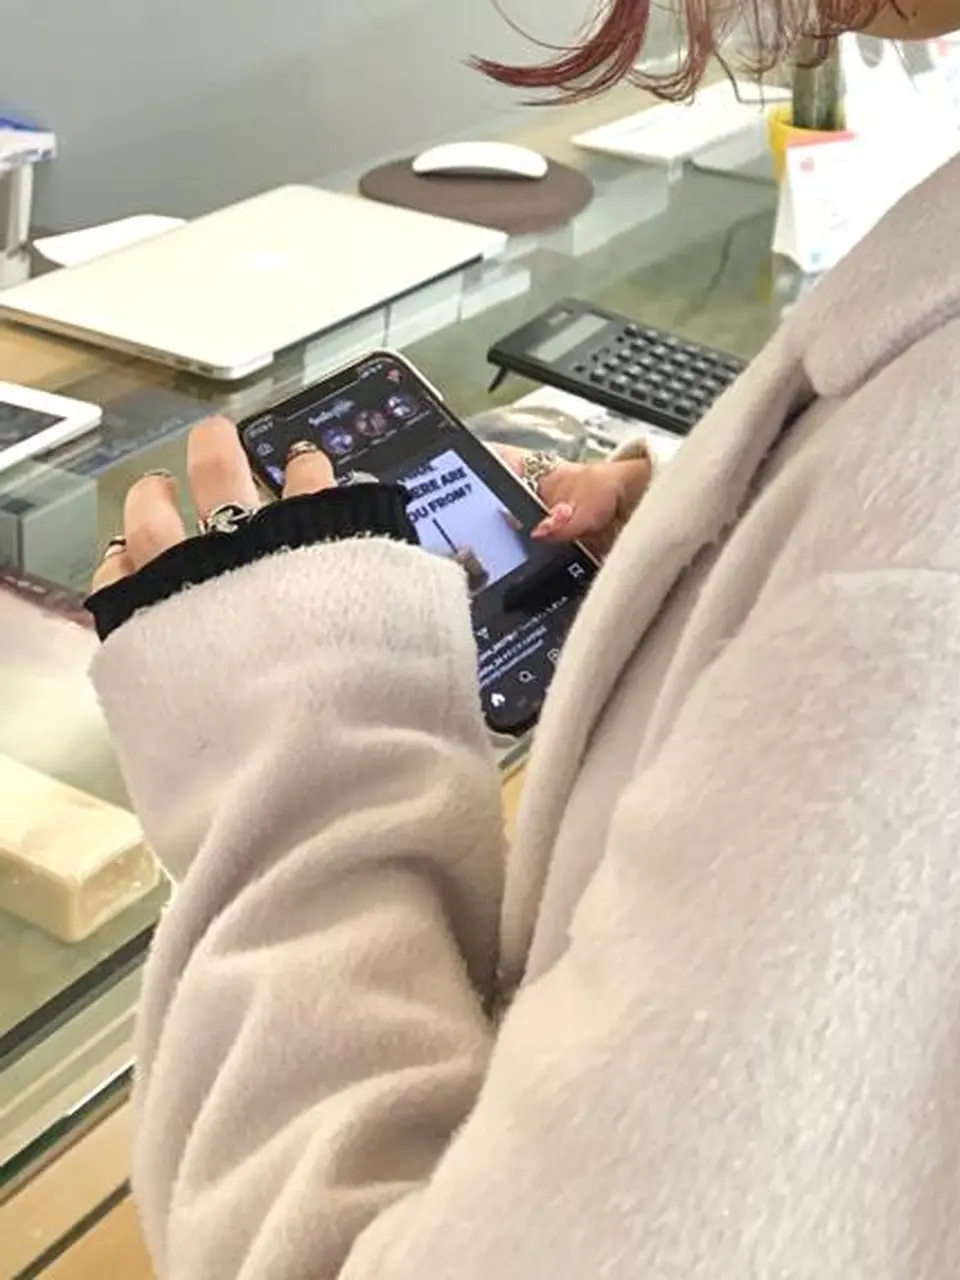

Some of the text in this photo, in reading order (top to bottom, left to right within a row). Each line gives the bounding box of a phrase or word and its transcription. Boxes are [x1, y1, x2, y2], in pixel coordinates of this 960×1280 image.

[408, 478, 441, 499] ERE
[440, 467, 467, 487] ARE
[408, 483, 472, 523] OU FROM?
